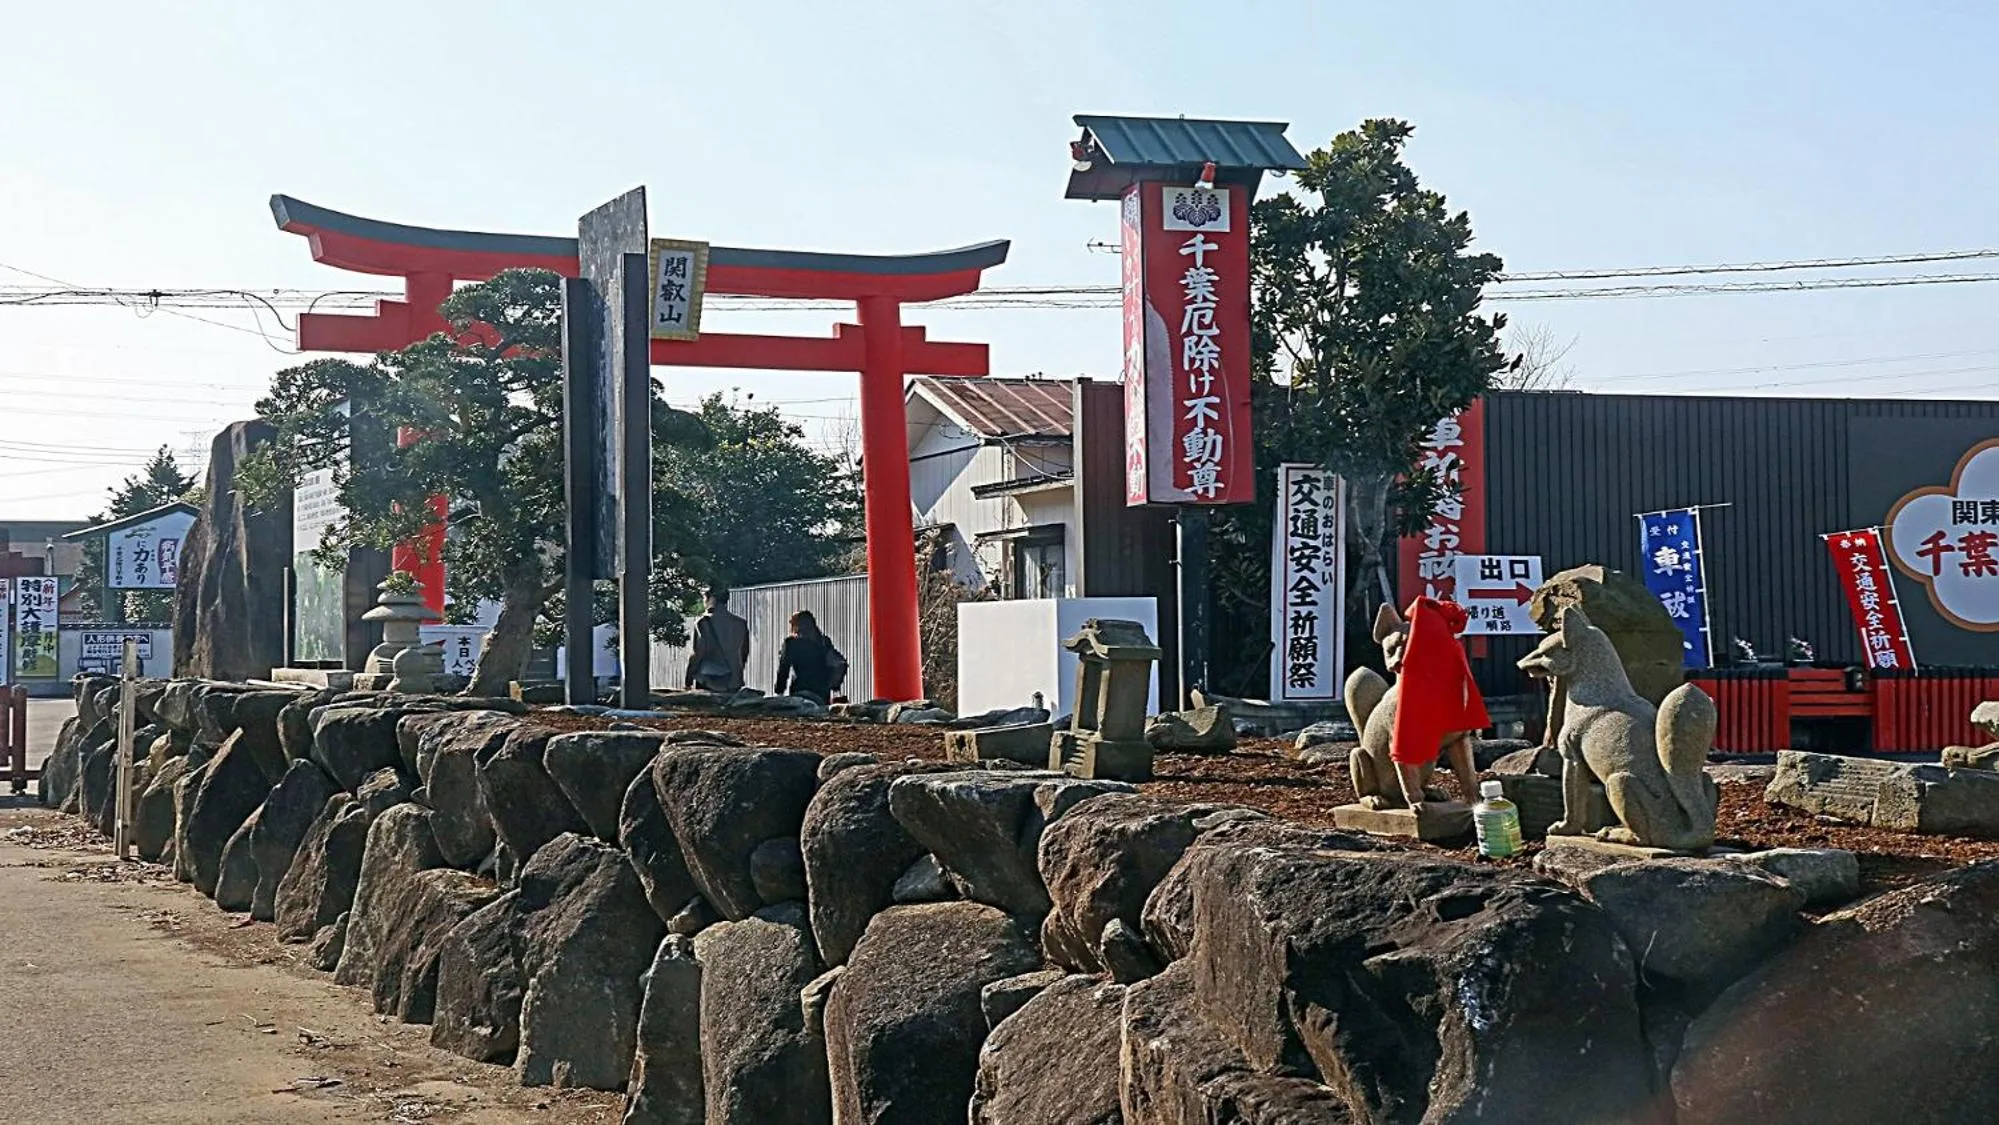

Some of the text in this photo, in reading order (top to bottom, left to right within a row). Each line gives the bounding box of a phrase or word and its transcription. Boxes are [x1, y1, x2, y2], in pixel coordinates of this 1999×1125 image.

[659, 257, 687, 324] 関叡山
[1179, 233, 1225, 498] 千葉厄除け不動尊
[1322, 476, 1335, 585] 車のおはらい
[1650, 525, 1679, 536] 受付
[1952, 500, 1999, 525] 関東
[1480, 558, 1530, 581] 出口
[1916, 530, 1999, 577] 千葉
[1288, 474, 1321, 688] 交通安全祈願祭
[1486, 620, 1511, 632] 順路
[1850, 552, 1899, 669] 交通安全祈願
[458, 636, 471, 657] 本日
